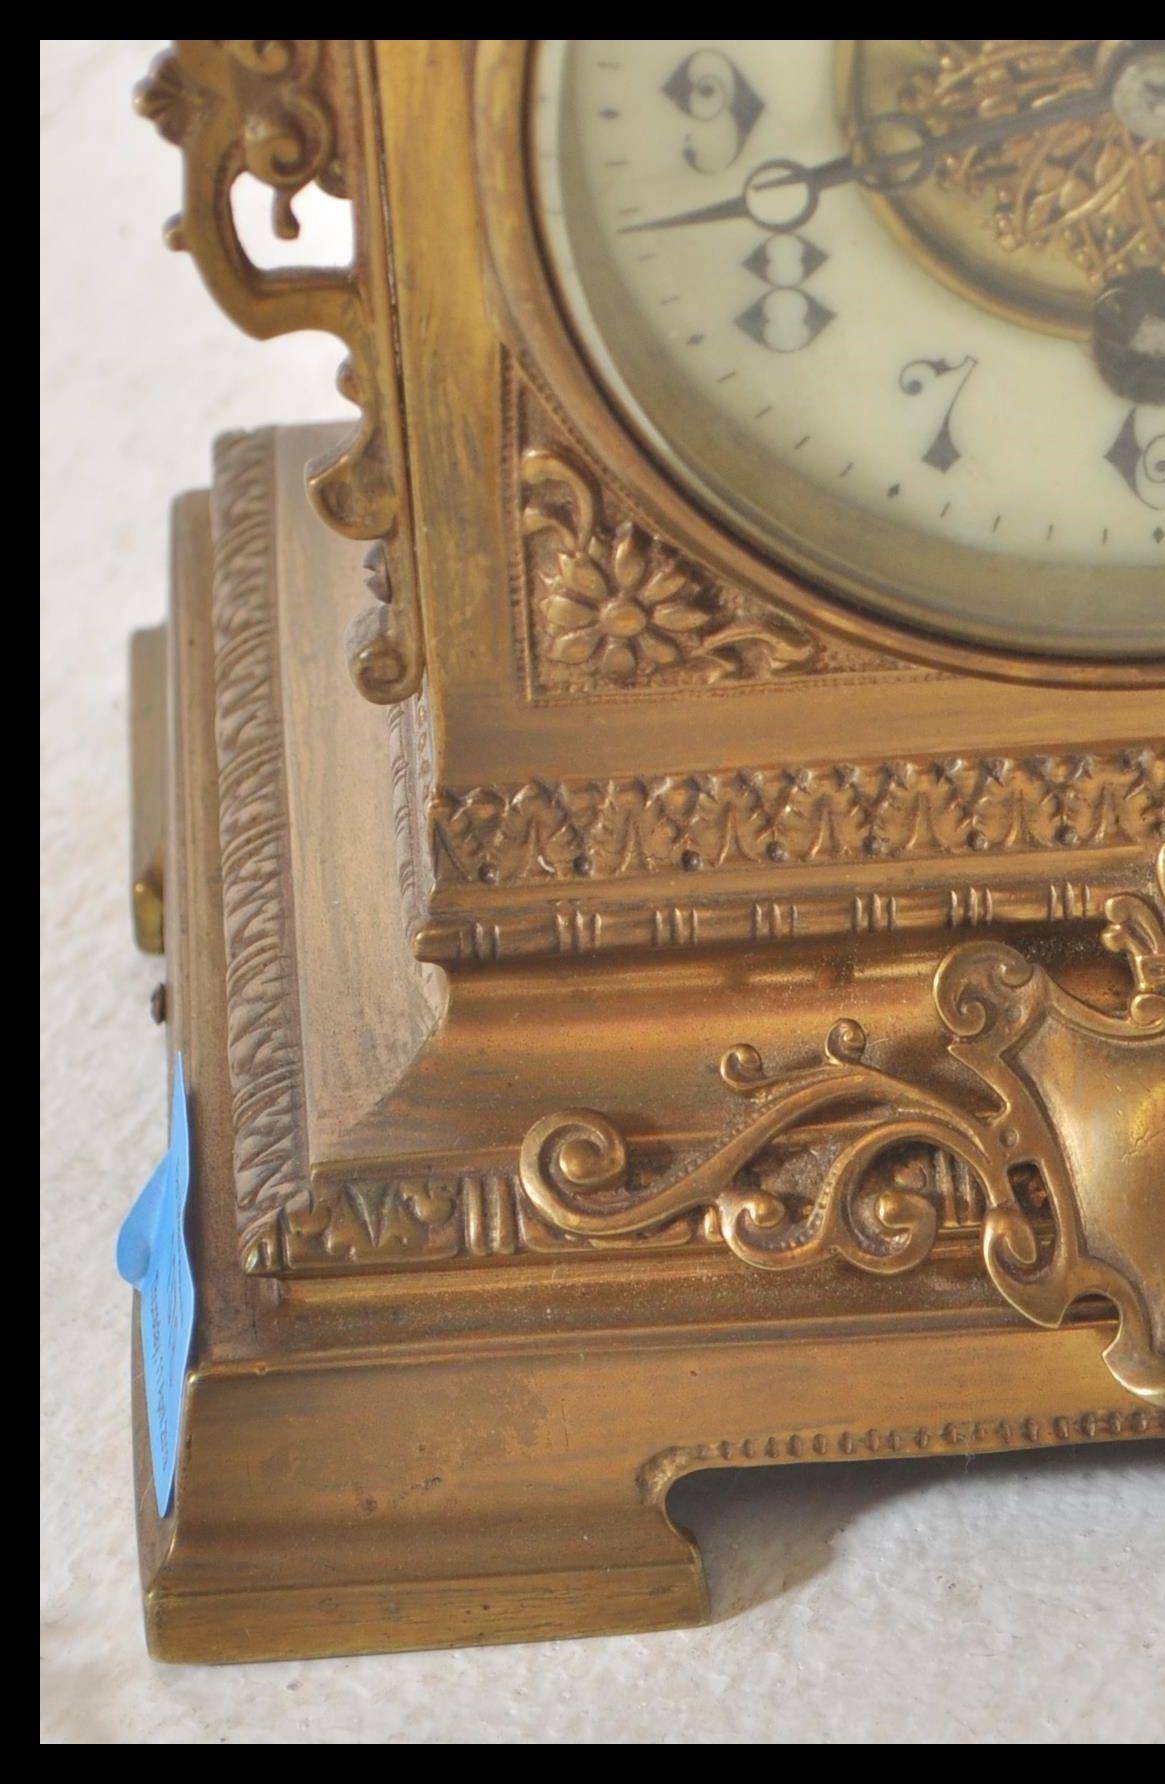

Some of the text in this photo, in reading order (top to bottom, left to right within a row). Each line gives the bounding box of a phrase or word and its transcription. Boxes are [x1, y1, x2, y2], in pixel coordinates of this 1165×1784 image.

[661, 48, 765, 175] 9
[733, 231, 839, 354] 8
[898, 355, 980, 473] 7
